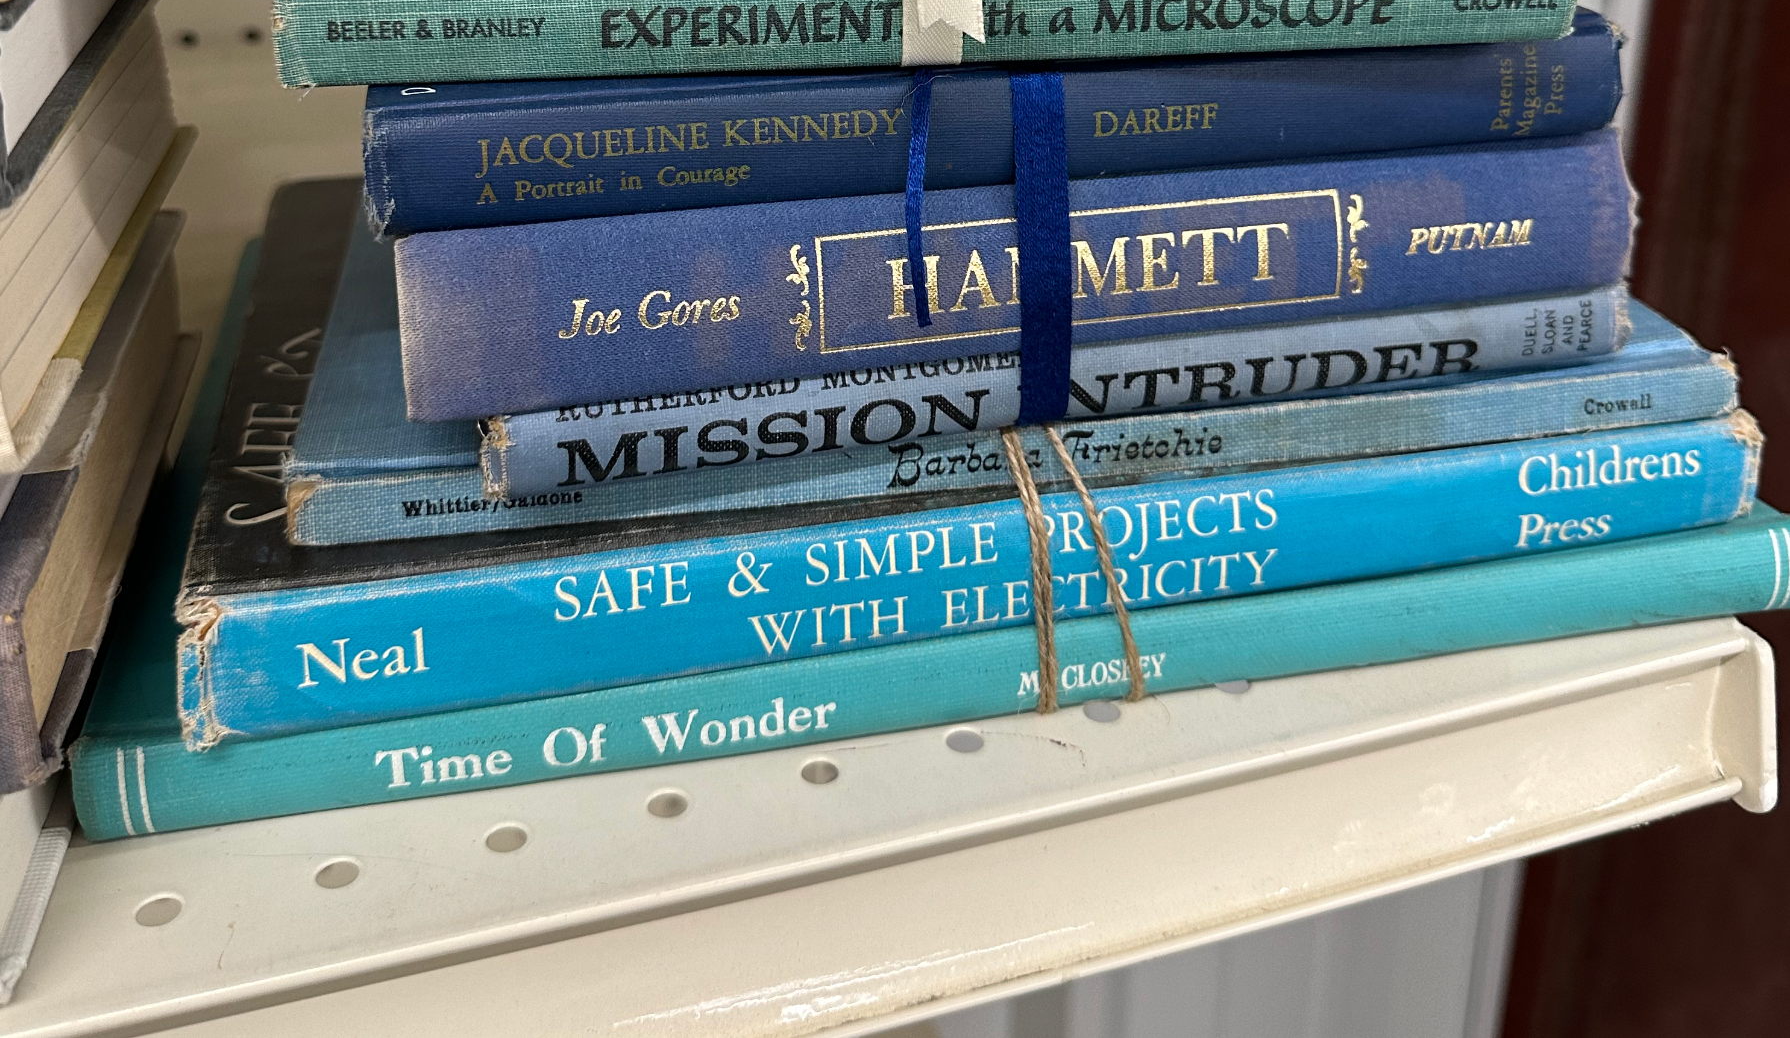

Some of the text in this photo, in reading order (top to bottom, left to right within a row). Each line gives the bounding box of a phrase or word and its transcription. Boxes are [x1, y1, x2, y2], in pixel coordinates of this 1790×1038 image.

[327, 20, 406, 43] BEELER
[416, 19, 433, 40] &
[443, 17, 545, 40] BRANLEY
[600, 1, 903, 49] EXPERIMENT
[1048, 8, 1076, 35] a
[1512, 45, 1541, 136] Magazine
[1544, 65, 1564, 115] Press
[475, 103, 1218, 177] JACQUELINE KENNEDY DAREFF
[477, 162, 751, 204] A Portrait in Courage
[558, 219, 1534, 339] Joe Gores HAMETT PUTNAM
[1542, 309, 1556, 354] SLOAN
[1562, 314, 1574, 345] AND
[1577, 300, 1593, 352] PEARCE
[821, 351, 1022, 390] MONTGOME
[557, 337, 1480, 486] MISSION NTRUDER
[888, 442, 1043, 488] Barbaa
[1584, 393, 1652, 415] Crowell
[1518, 443, 1700, 497] Childrens
[1515, 513, 1612, 550] Press
[554, 561, 693, 622] SAFE
[727, 551, 773, 598] &
[806, 521, 999, 587] SIMPLE
[748, 596, 908, 655] WITH
[296, 628, 430, 690] Neal
[374, 747, 513, 788] Time
[543, 723, 606, 766] Of
[641, 697, 837, 755] Wonder
